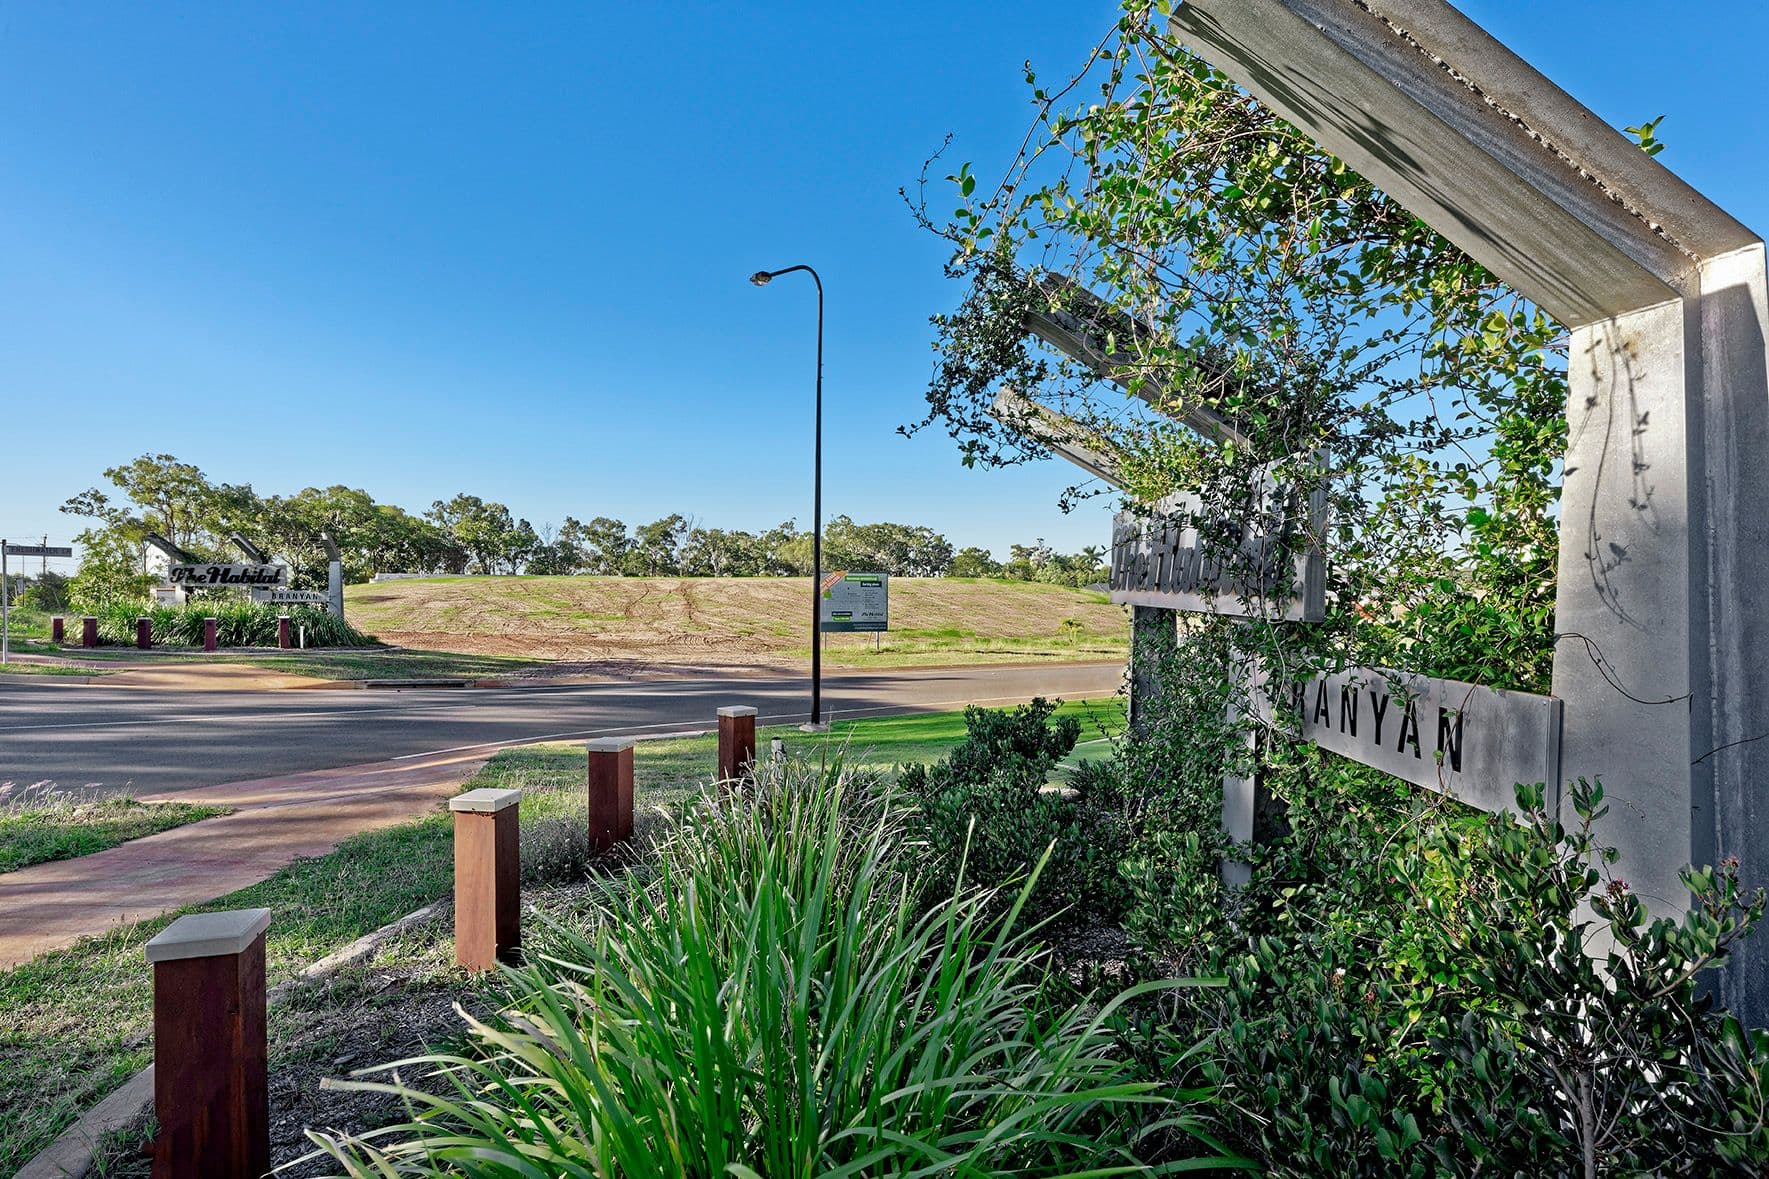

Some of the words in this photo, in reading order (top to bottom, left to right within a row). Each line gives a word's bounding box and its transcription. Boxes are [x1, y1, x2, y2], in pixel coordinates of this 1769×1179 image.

[169, 566, 206, 584] The
[205, 566, 282, 585] Habitat
[271, 592, 319, 601] BRANYAN
[1291, 677, 1464, 773] RANYAN
